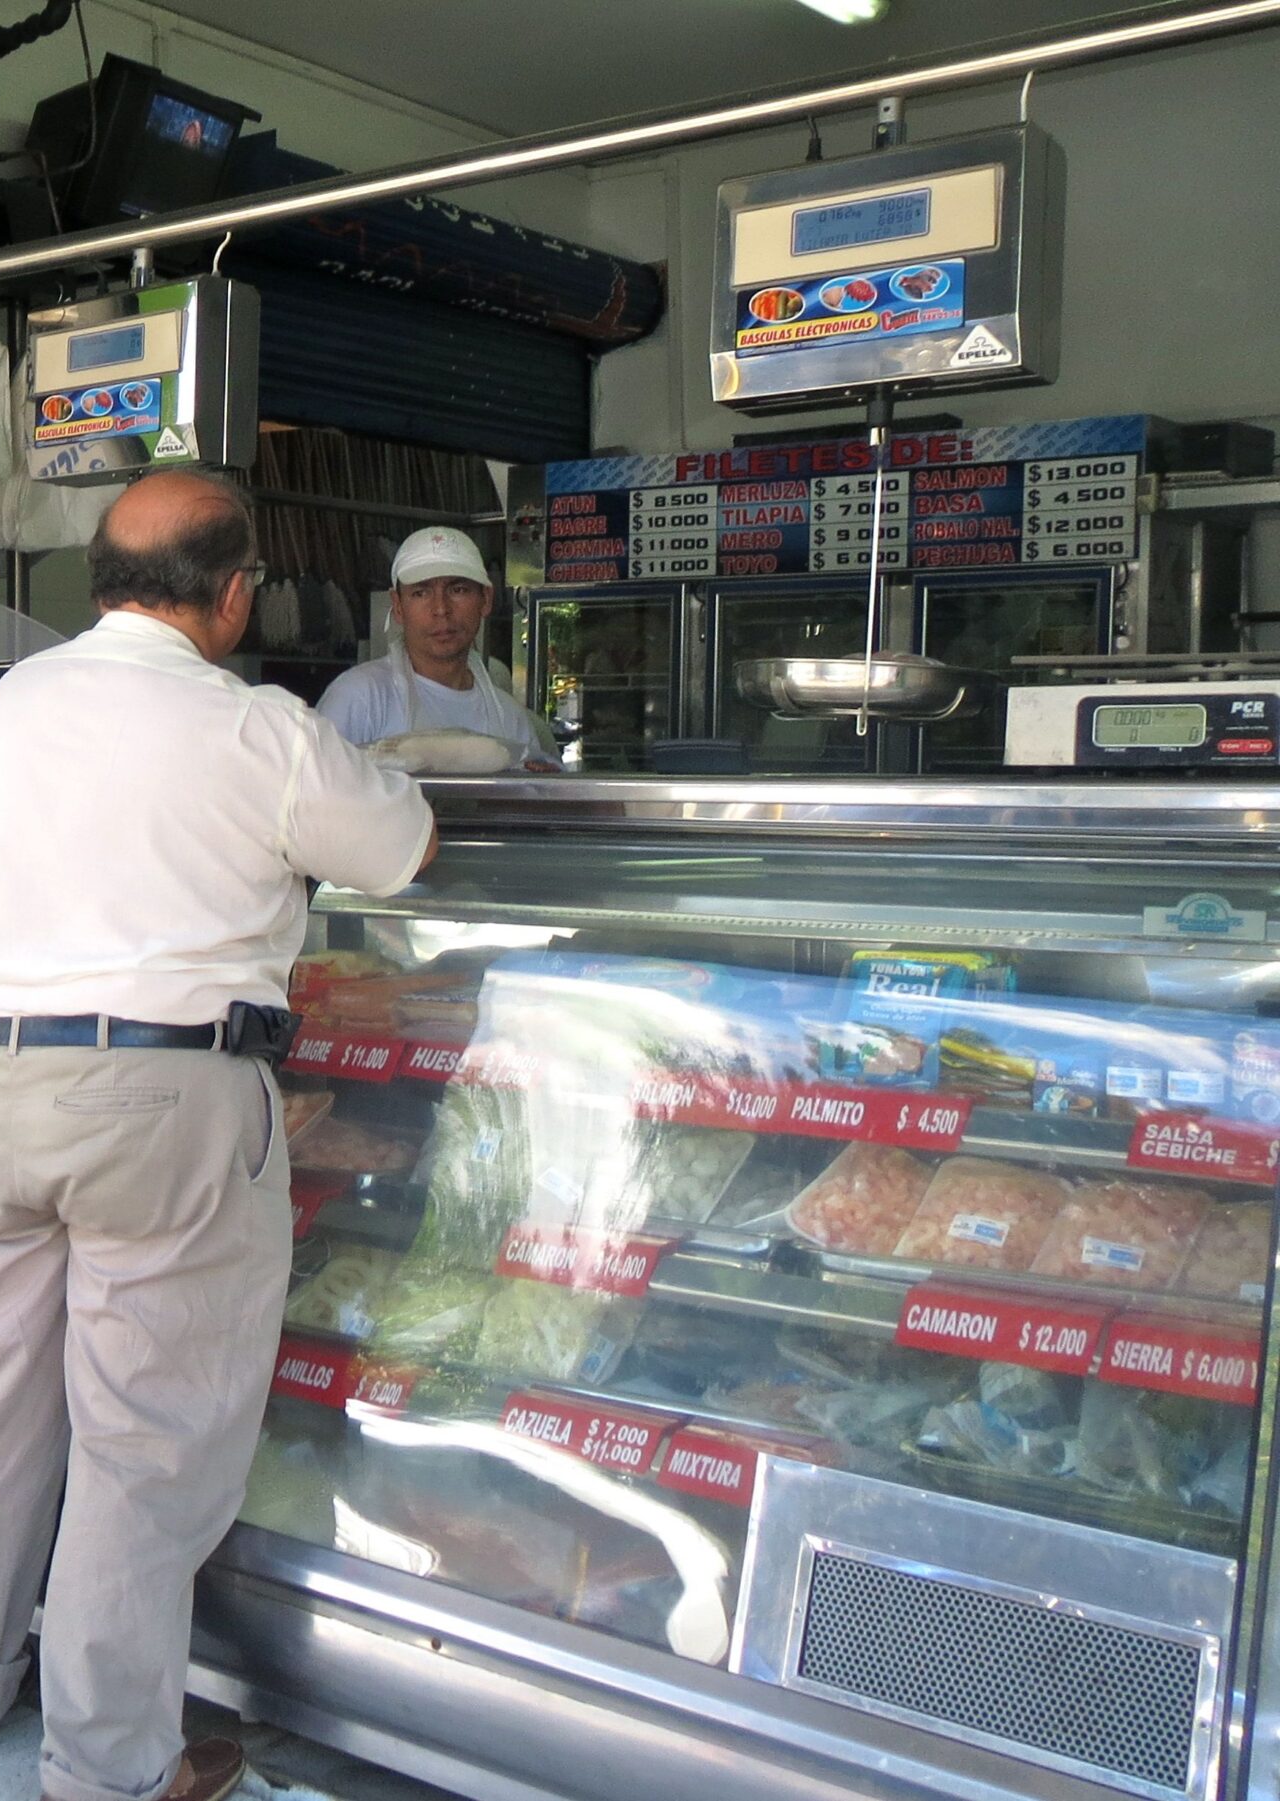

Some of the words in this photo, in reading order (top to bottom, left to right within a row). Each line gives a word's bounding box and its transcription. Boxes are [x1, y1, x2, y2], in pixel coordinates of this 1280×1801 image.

[740, 327, 793, 346] BASCULAS
[957, 348, 1008, 361] EPELSA
[676, 440, 873, 482] FILETES
[914, 466, 1008, 492] SALMON
[1028, 464, 1042, 484] $
[551, 495, 597, 515] ATUN
[632, 491, 644, 510] $
[721, 480, 808, 503] MERLUZA
[814, 480, 826, 498] $
[914, 494, 985, 516] BASA
[1028, 489, 1042, 508] $
[1053, 486, 1126, 504] 4.500
[551, 516, 608, 537] BAGRE
[632, 514, 644, 532] $
[721, 505, 806, 526] TILAPIA
[814, 503, 826, 521] $
[721, 529, 783, 549] MERO
[813, 528, 826, 546] $
[914, 518, 979, 541] ROBALO
[1027, 515, 1041, 535] $
[550, 538, 626, 560] CORVINA
[632, 537, 644, 556] $
[912, 543, 1016, 567] PECHUGA
[1026, 541, 1040, 560] $
[549, 560, 620, 583] CHERNA
[631, 559, 643, 578] $
[721, 555, 779, 575] TOYO
[813, 552, 826, 570] $
[1231, 701, 1266, 714] PCR
[296, 1038, 334, 1063] BAGRE
[340, 1044, 353, 1068] $
[351, 1045, 390, 1070] 11.000
[409, 1046, 470, 1074] HUESO
[791, 1095, 865, 1128] PALMITO
[897, 1104, 910, 1133] $
[917, 1105, 960, 1136] 4.500
[1145, 1123, 1214, 1146] SALSA
[1140, 1140, 1238, 1166] CEBICHE
[505, 1239, 578, 1270] CAMARON
[906, 1304, 997, 1343] CAMARON
[1018, 1320, 1032, 1350] $
[1034, 1324, 1088, 1357] 12.000
[1110, 1339, 1175, 1376] SIERRA
[1181, 1349, 1195, 1380] $
[1197, 1354, 1246, 1387] 6.000
[277, 1357, 335, 1391] ANILLOS
[353, 1378, 367, 1401] $
[504, 1408, 574, 1447] CAZUELA
[587, 1418, 600, 1438] $
[602, 1421, 650, 1447] 7.000
[667, 1448, 743, 1489] MIXTURA
